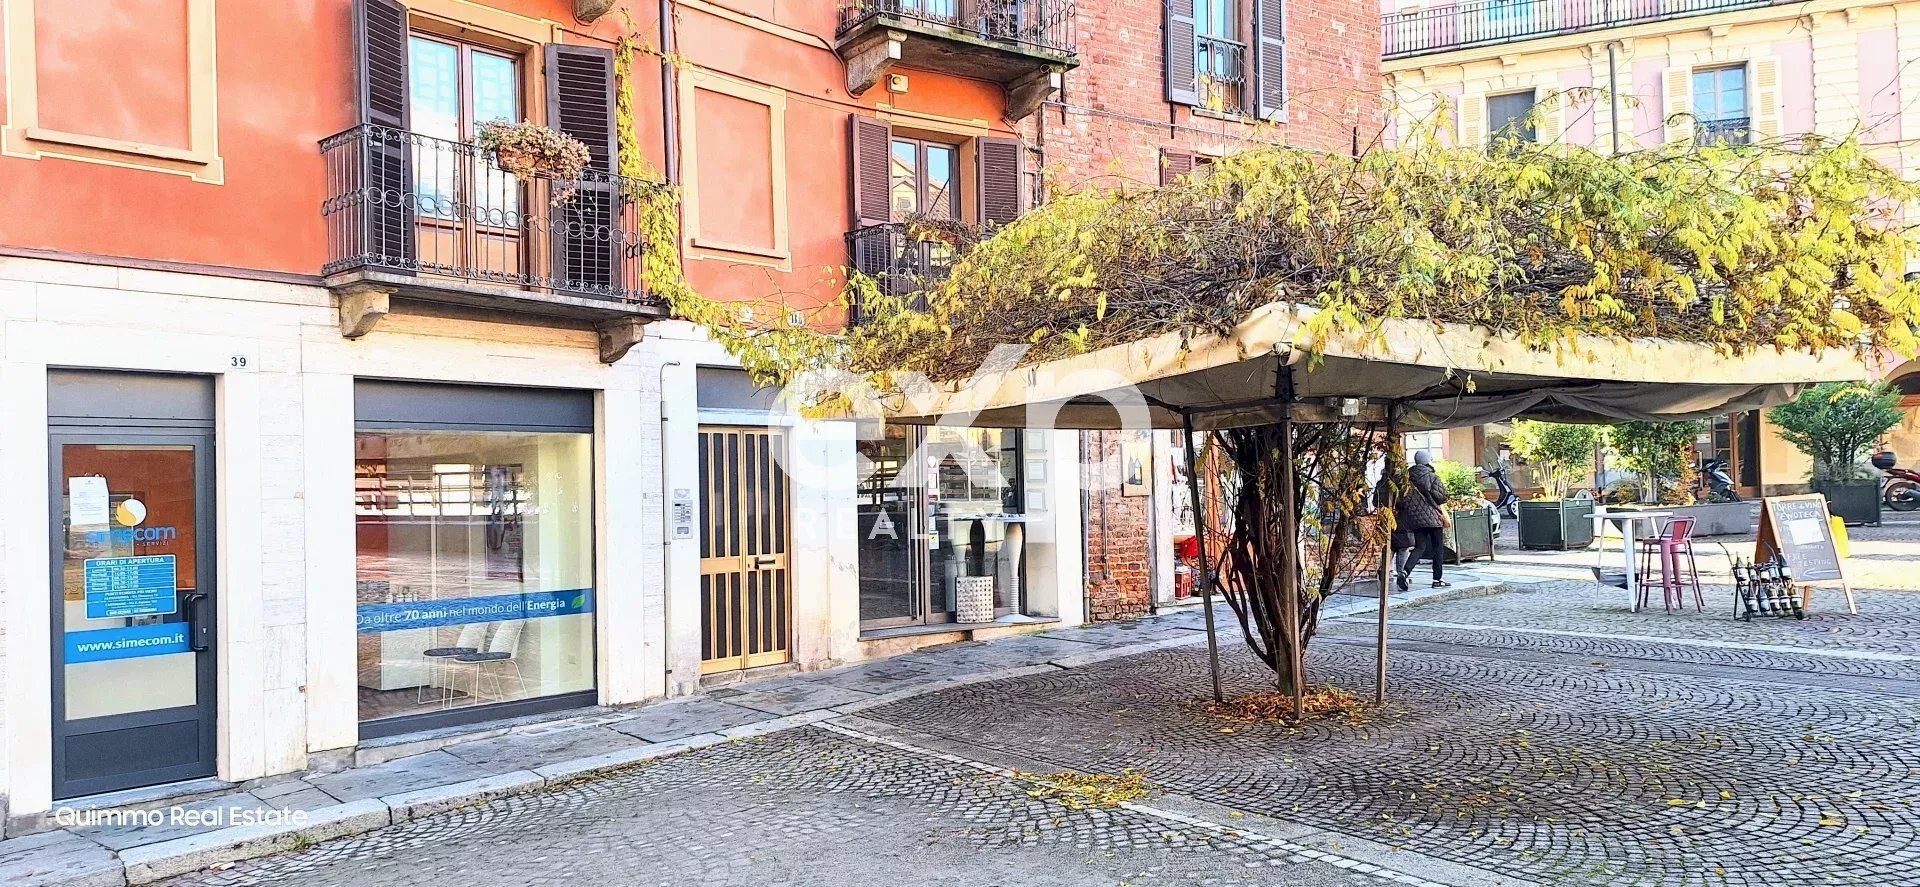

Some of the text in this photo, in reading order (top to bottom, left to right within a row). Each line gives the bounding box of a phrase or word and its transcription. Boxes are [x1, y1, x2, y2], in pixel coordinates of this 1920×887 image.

[231, 356, 247, 367] 39
[128, 557, 165, 565] APERTURA
[356, 598, 566, 625] Da oltre 70 anni nel mondo dell'Energia
[77, 633, 184, 652] www.simecom.it
